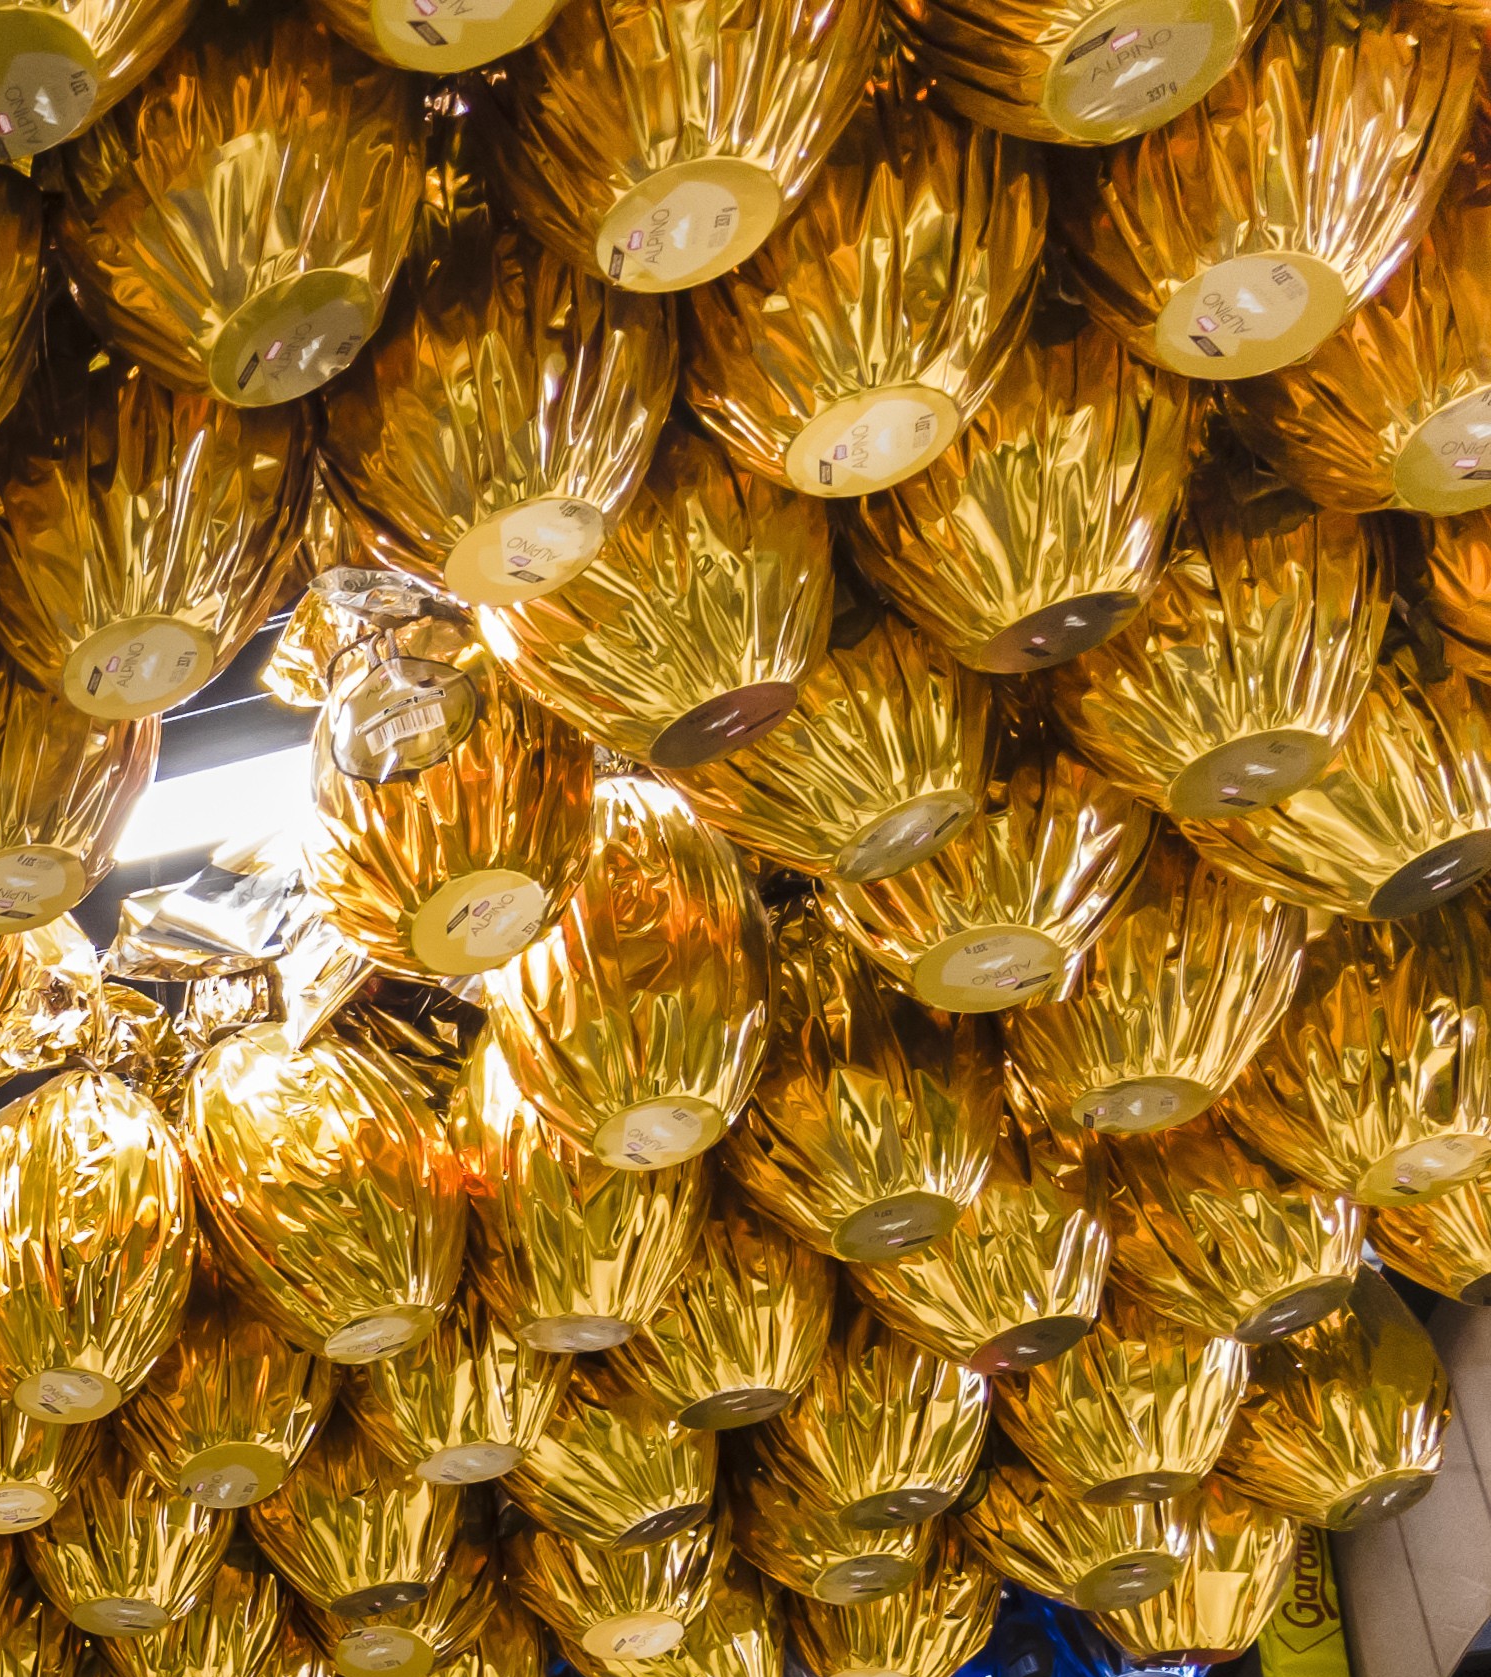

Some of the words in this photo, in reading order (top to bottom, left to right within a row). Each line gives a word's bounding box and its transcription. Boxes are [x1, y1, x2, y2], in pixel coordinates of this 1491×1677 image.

[1089, 29, 1174, 82] ALPINO
[645, 208, 671, 265] ALPINO
[1202, 292, 1253, 336] ALPINO
[851, 424, 869, 469] ALPINO
[507, 535, 559, 562] ALPINO
[117, 642, 145, 689] ALPINO
[470, 893, 515, 937] ALPINO
